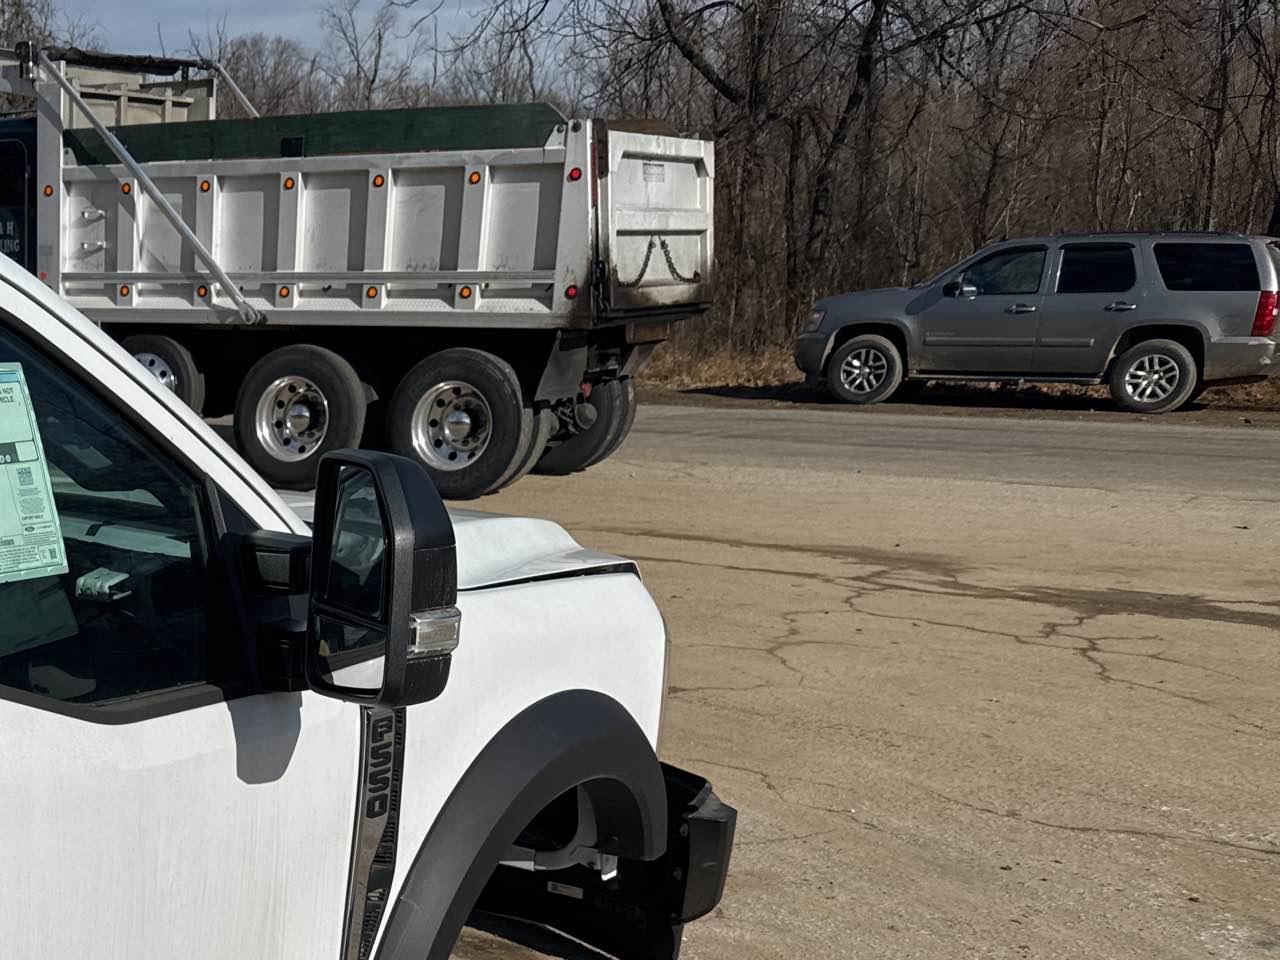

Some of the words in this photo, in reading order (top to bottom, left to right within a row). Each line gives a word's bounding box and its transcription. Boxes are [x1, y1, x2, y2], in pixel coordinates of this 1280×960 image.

[6, 220, 14, 236] H
[1, 387, 14, 395] NOT
[365, 716, 393, 819] F550
